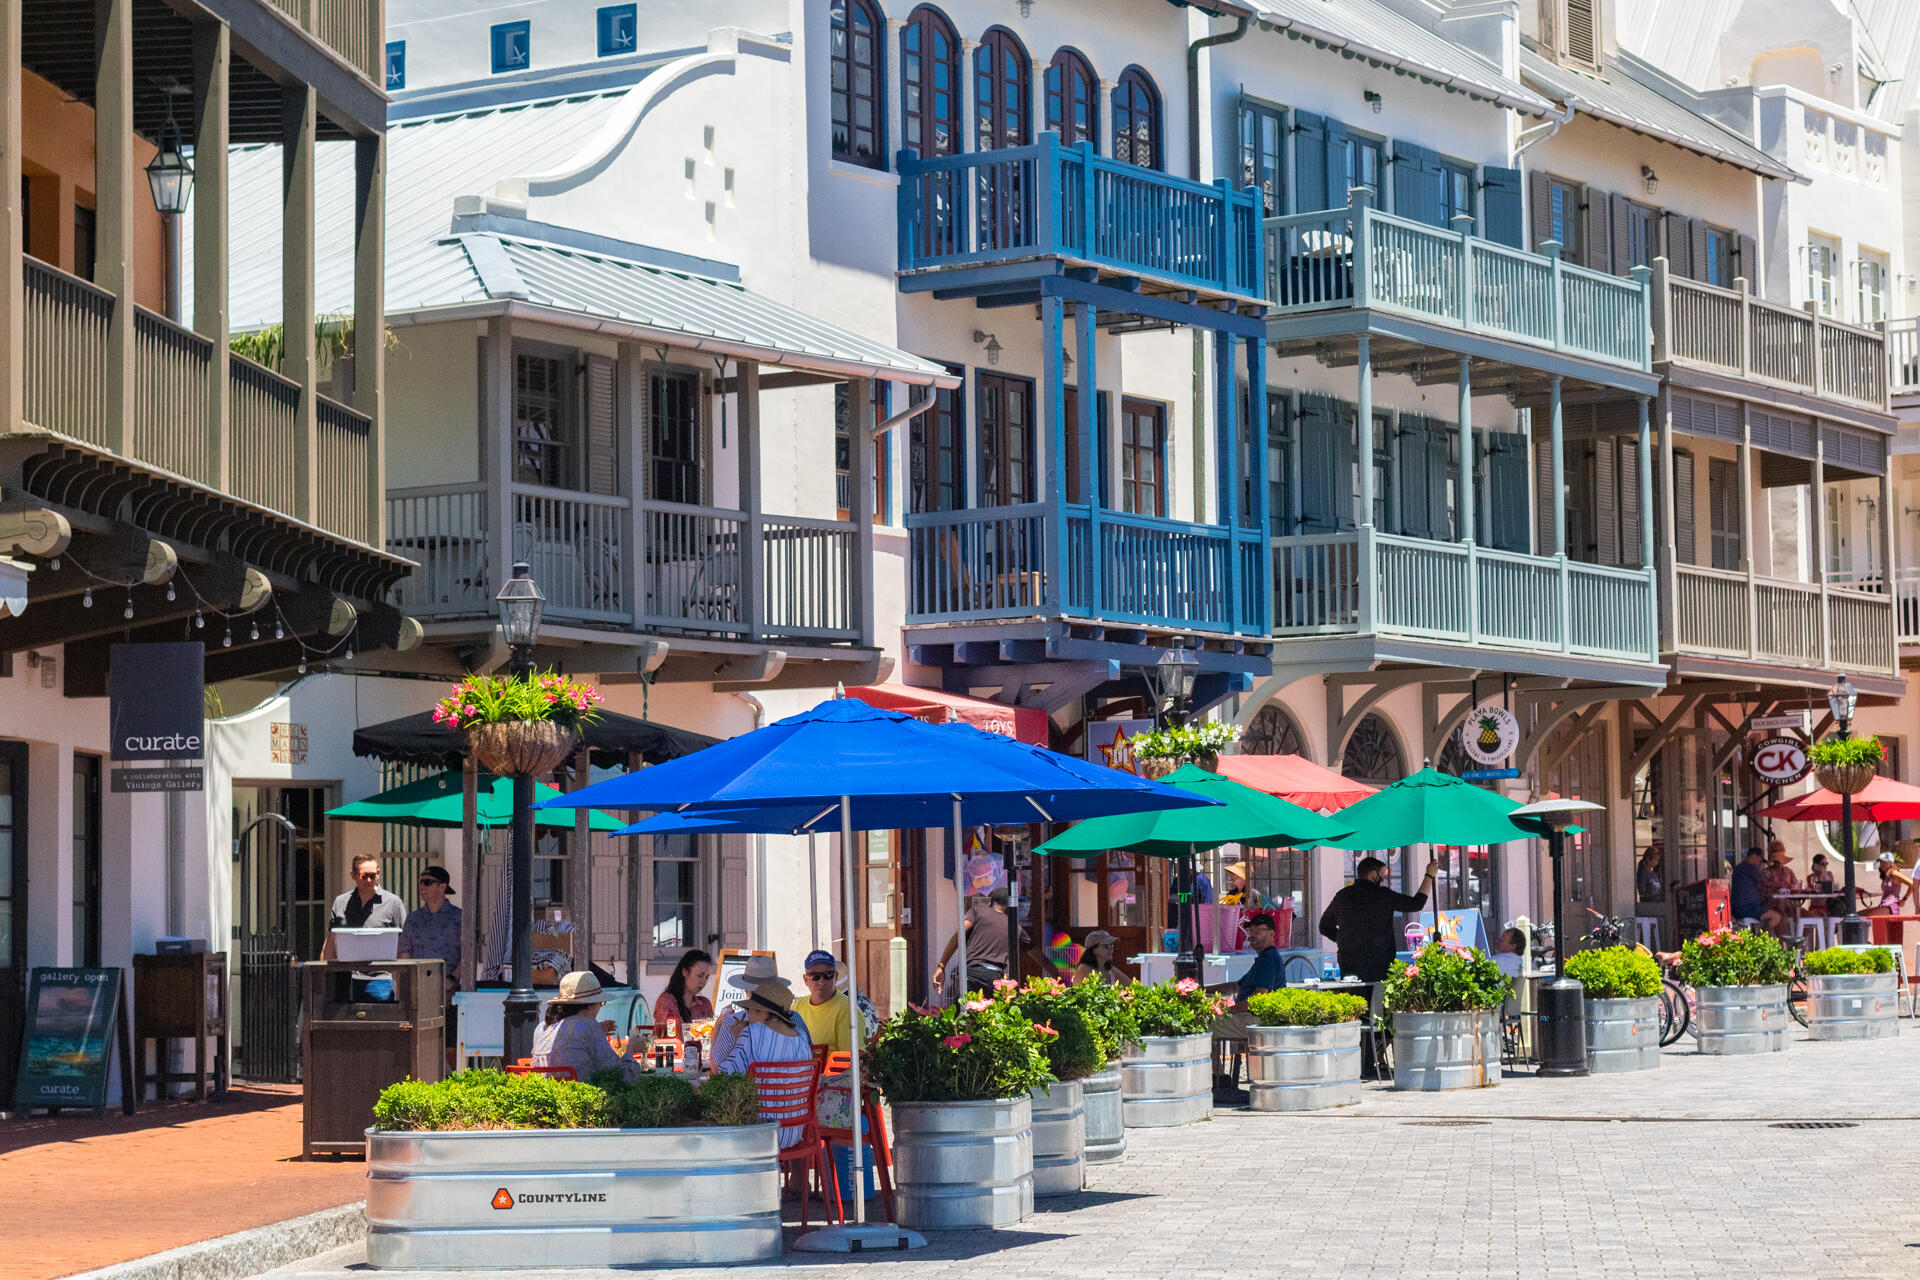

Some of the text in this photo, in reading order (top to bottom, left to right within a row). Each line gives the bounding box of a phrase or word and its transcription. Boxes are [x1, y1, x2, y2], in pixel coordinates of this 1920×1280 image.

[1468, 707, 1512, 726] PLAYA BOWLS
[983, 719, 1013, 735] TOYS
[125, 732, 200, 751] curate
[1758, 737, 1800, 749] COWGIRL
[1757, 750, 1799, 772] CK
[1760, 772, 1802, 784] KITCHEN
[126, 781, 202, 790] Vinings Gallery
[40, 972, 109, 984] gallery open
[719, 989, 743, 1002] Join
[40, 1084, 80, 1095] curate
